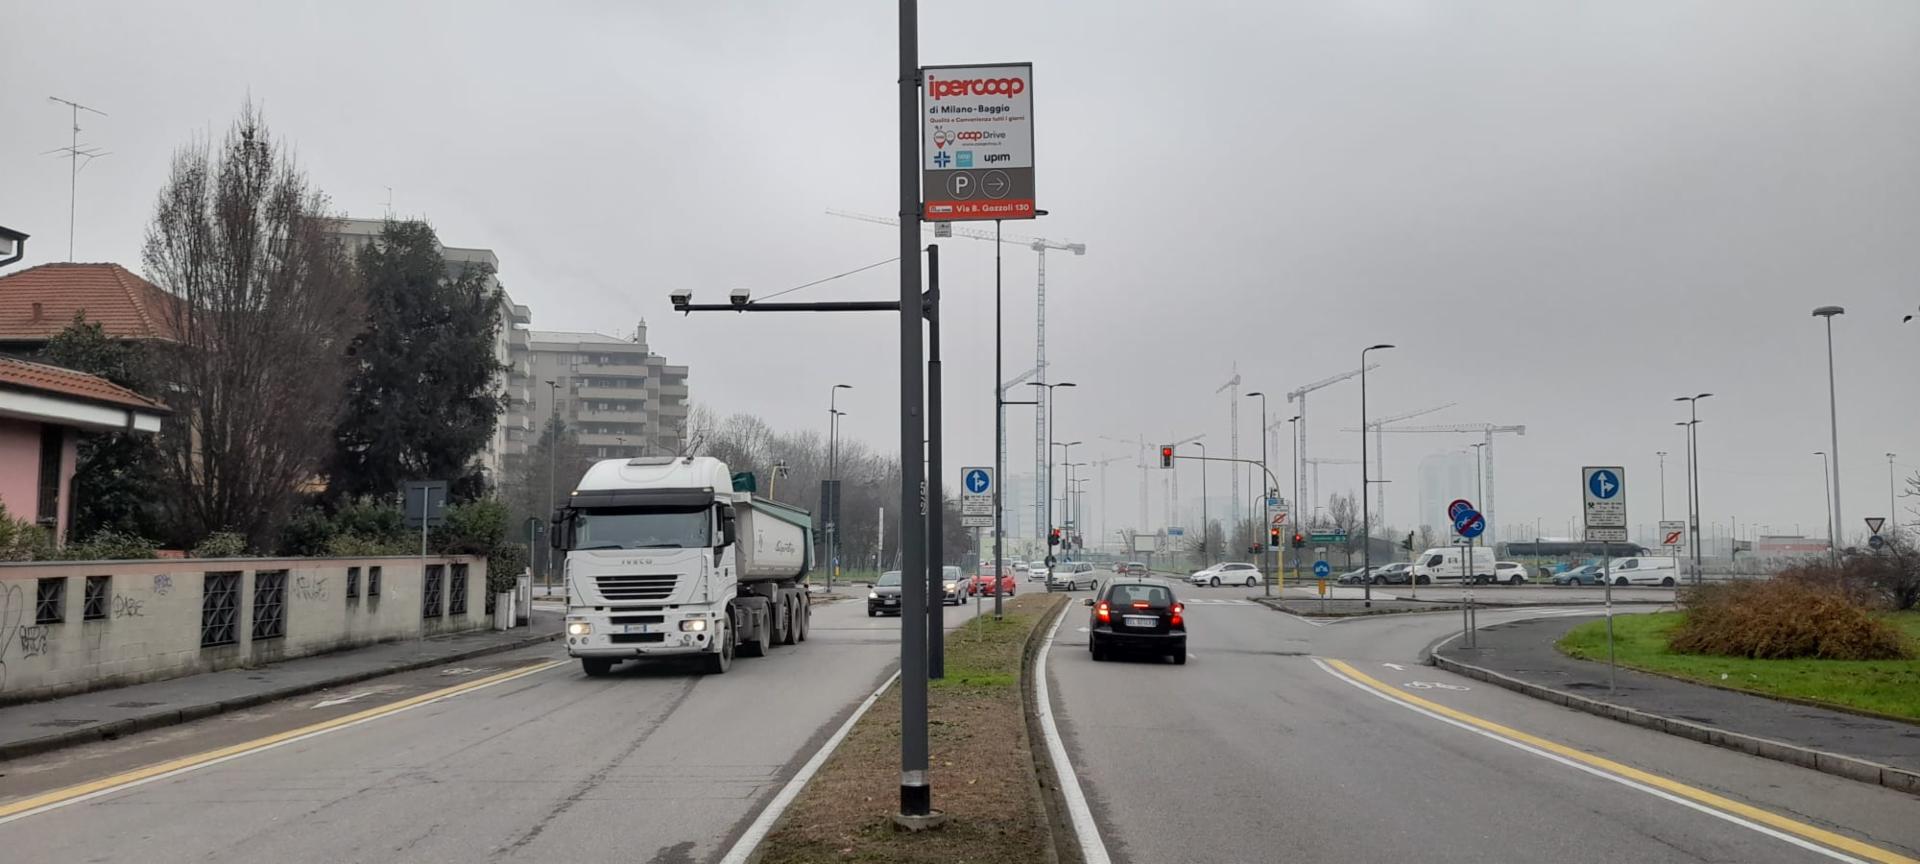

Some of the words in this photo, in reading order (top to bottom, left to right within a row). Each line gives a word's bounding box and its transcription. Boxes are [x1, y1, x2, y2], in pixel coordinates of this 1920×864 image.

[929, 75, 1024, 100] ipercoop
[930, 106, 939, 114] di
[957, 131, 982, 141] coop
[983, 131, 1006, 139] Drive
[984, 153, 1010, 163] upim
[956, 176, 968, 194] P
[956, 204, 970, 213] Via
